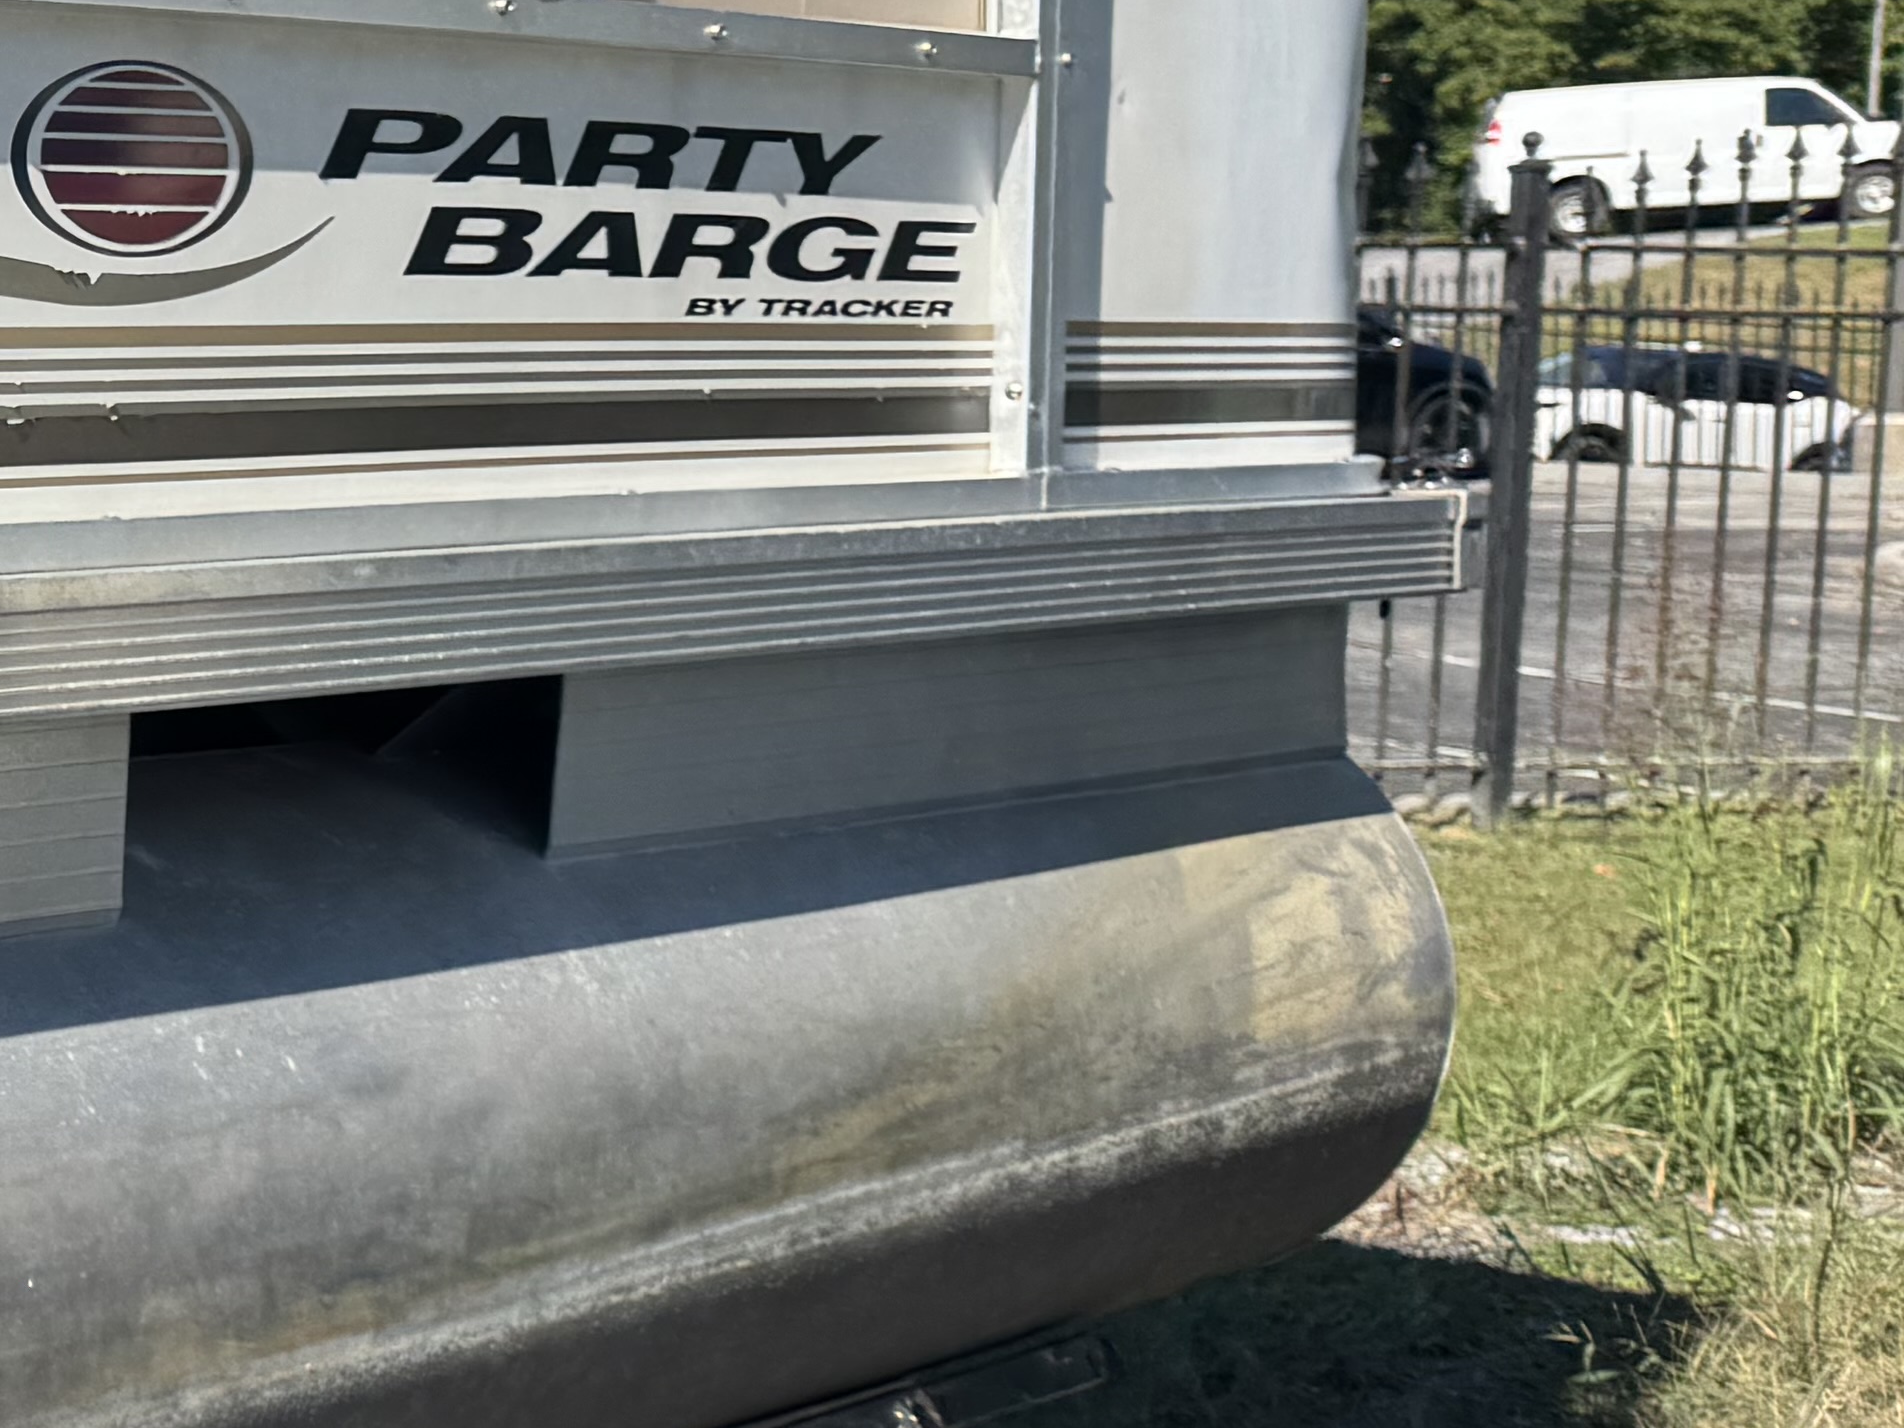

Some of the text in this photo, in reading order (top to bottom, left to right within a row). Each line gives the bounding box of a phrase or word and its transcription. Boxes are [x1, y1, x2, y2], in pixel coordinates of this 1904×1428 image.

[319, 108, 882, 195] PARTY
[403, 206, 976, 282] BARGE
[685, 298, 953, 317] BY TRACKER
